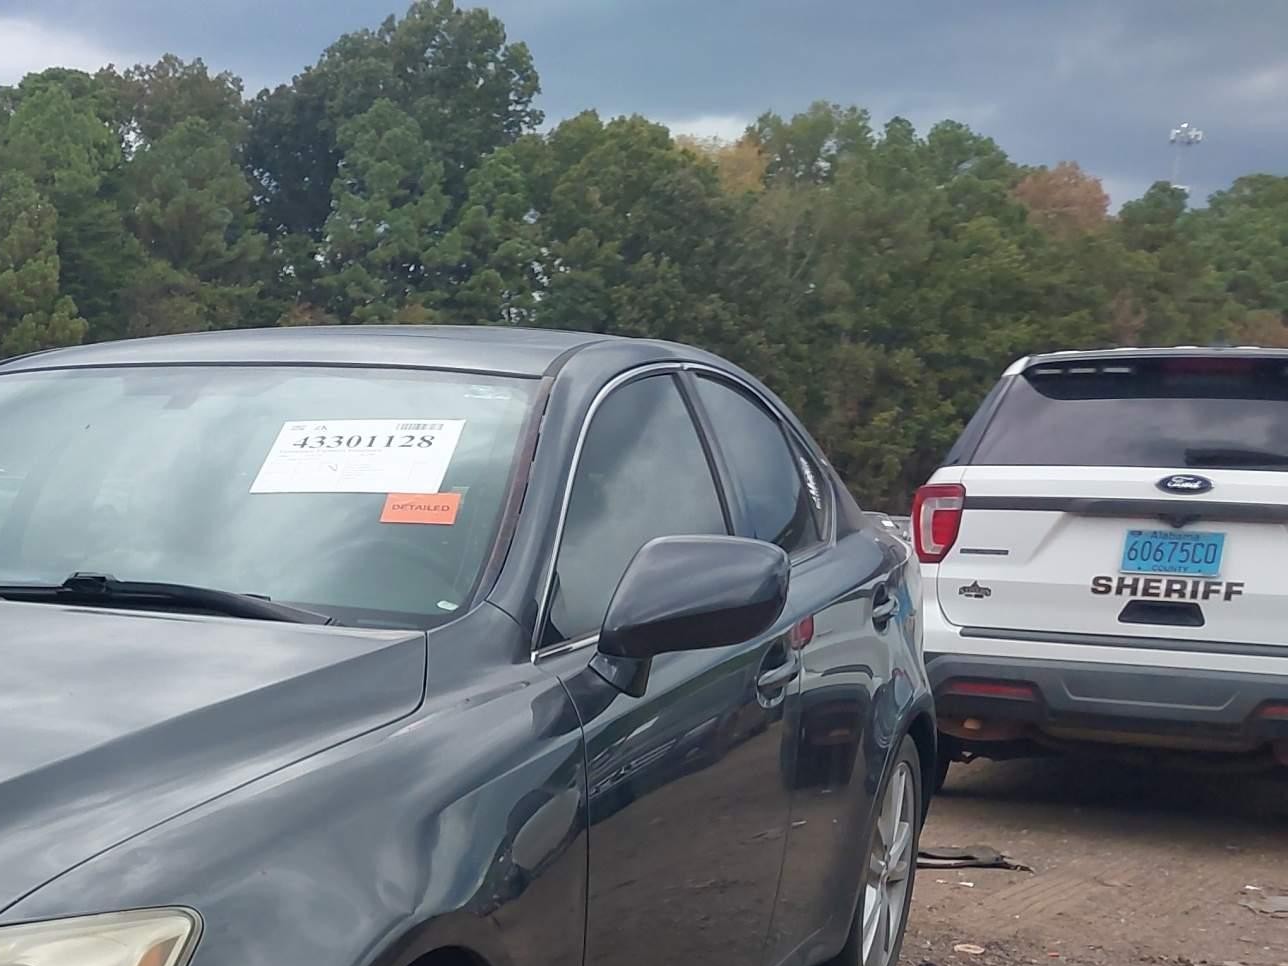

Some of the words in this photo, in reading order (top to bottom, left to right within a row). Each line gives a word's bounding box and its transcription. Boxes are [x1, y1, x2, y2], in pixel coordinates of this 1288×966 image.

[292, 435, 435, 449] 43301128
[1167, 476, 1202, 489] Ford
[391, 503, 451, 512] DETAILED
[1090, 576, 1245, 602] SHERIFF
